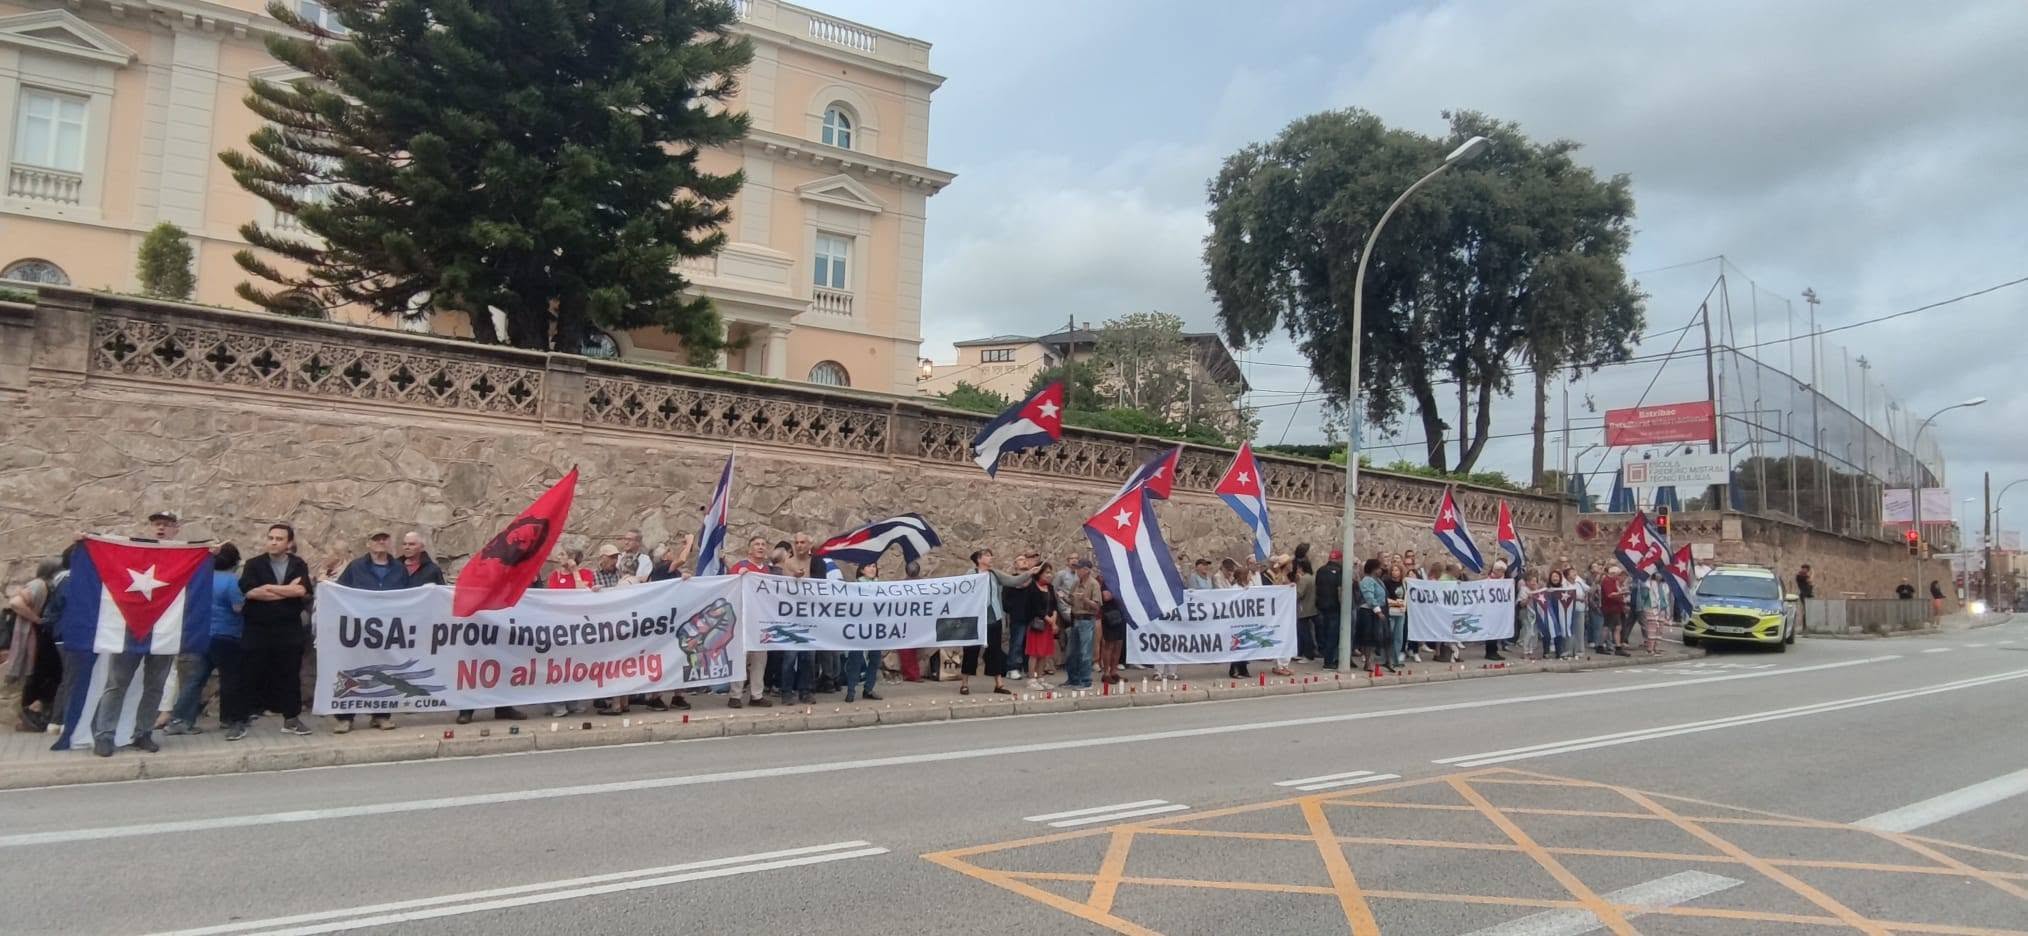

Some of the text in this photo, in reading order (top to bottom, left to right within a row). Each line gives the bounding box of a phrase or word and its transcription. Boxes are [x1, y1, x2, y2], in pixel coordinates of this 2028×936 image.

[756, 580, 847, 596] ATUREM
[1443, 590, 1459, 606] NO
[778, 601, 950, 618] DEIXEU VIURE A
[1212, 598, 1265, 620] LLIURE
[1271, 597, 1276, 616] I
[339, 607, 678, 655] USA: prou ingerències!
[842, 622, 907, 640] CUBA!
[1139, 632, 1223, 653] SOBIRANA
[457, 658, 501, 690] NO
[511, 656, 537, 687] al
[688, 663, 730, 680] ALBA
[331, 699, 448, 710] DEFENSEM CUBA
